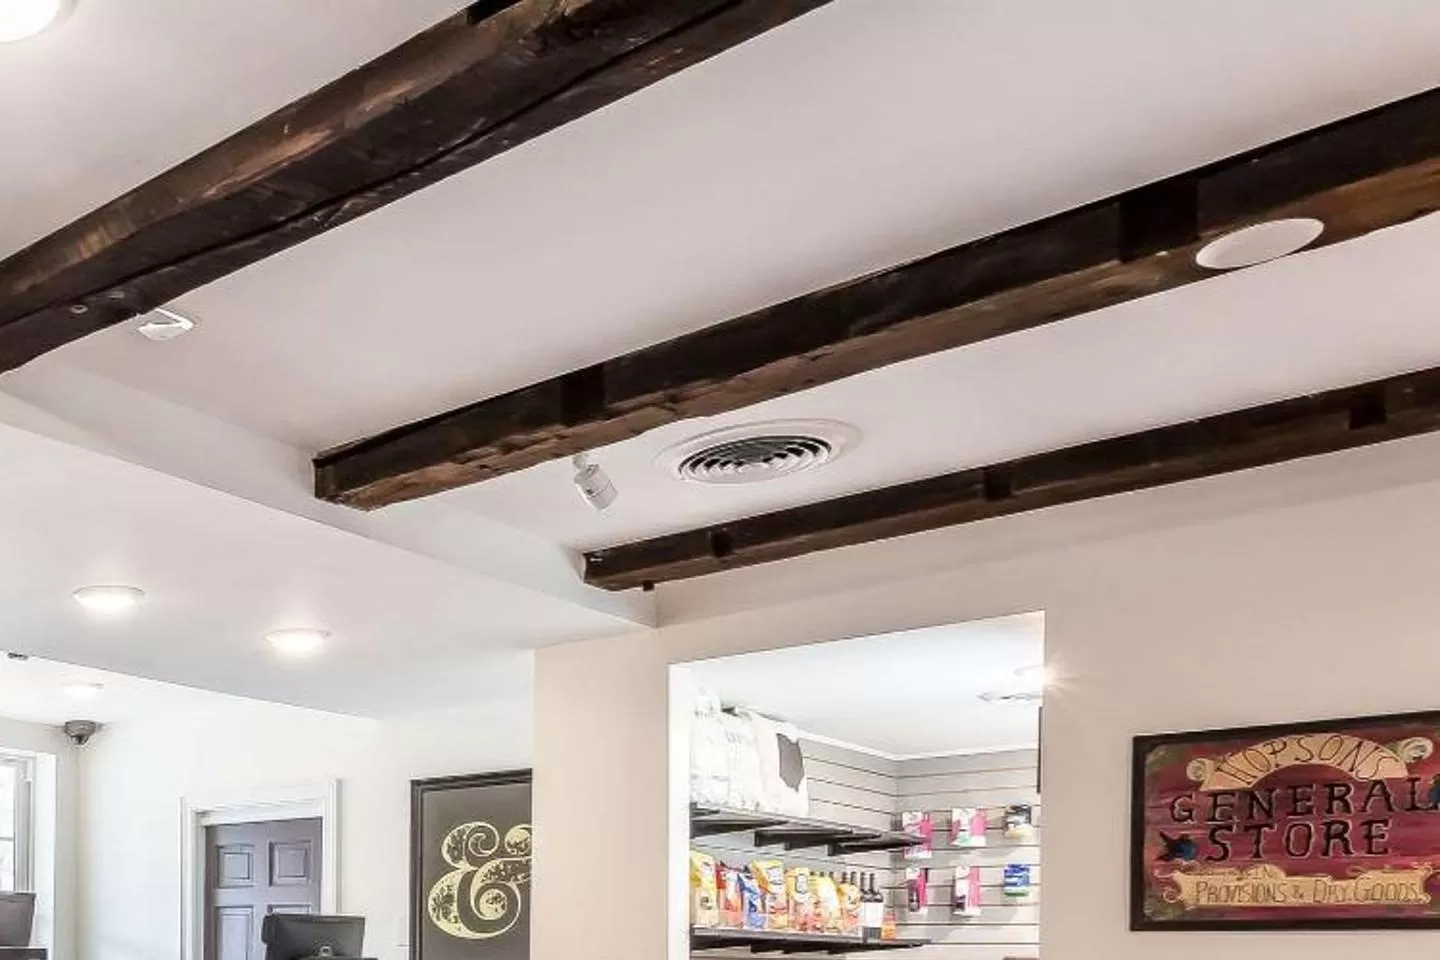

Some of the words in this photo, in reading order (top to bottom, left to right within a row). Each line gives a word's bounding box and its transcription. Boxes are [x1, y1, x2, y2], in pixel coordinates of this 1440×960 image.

[1170, 776, 1438, 823] GENERAL
[1206, 818, 1391, 862] STORE
[1196, 880, 1288, 904] PROVISIONS
